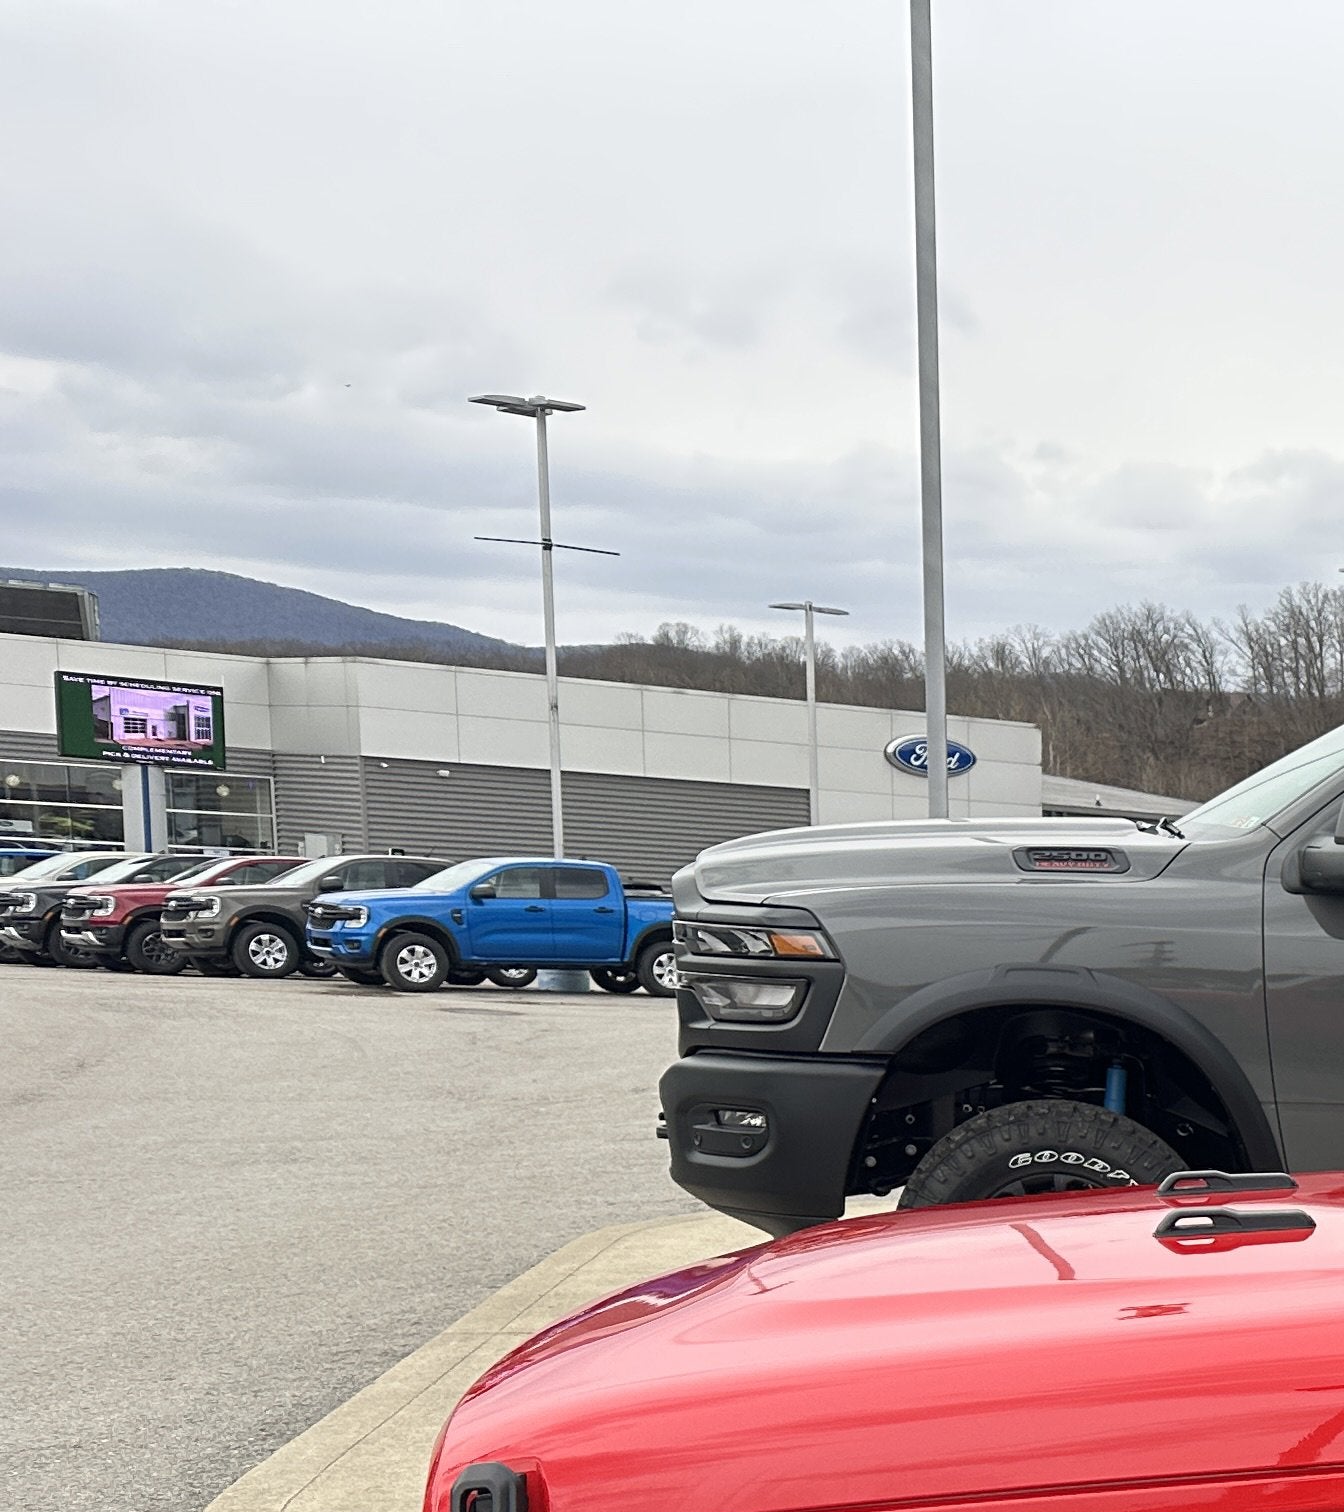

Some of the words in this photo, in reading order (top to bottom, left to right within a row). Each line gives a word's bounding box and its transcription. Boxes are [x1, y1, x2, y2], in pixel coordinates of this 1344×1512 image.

[63, 675, 84, 683] SAVE
[119, 681, 171, 692] SCHEDULING
[172, 687, 206, 695] SERVICE
[102, 750, 122, 758] PICK
[910, 744, 960, 769] Fd
[1032, 851, 1108, 861] 2500
[1009, 1150, 1139, 1187] GOODY
